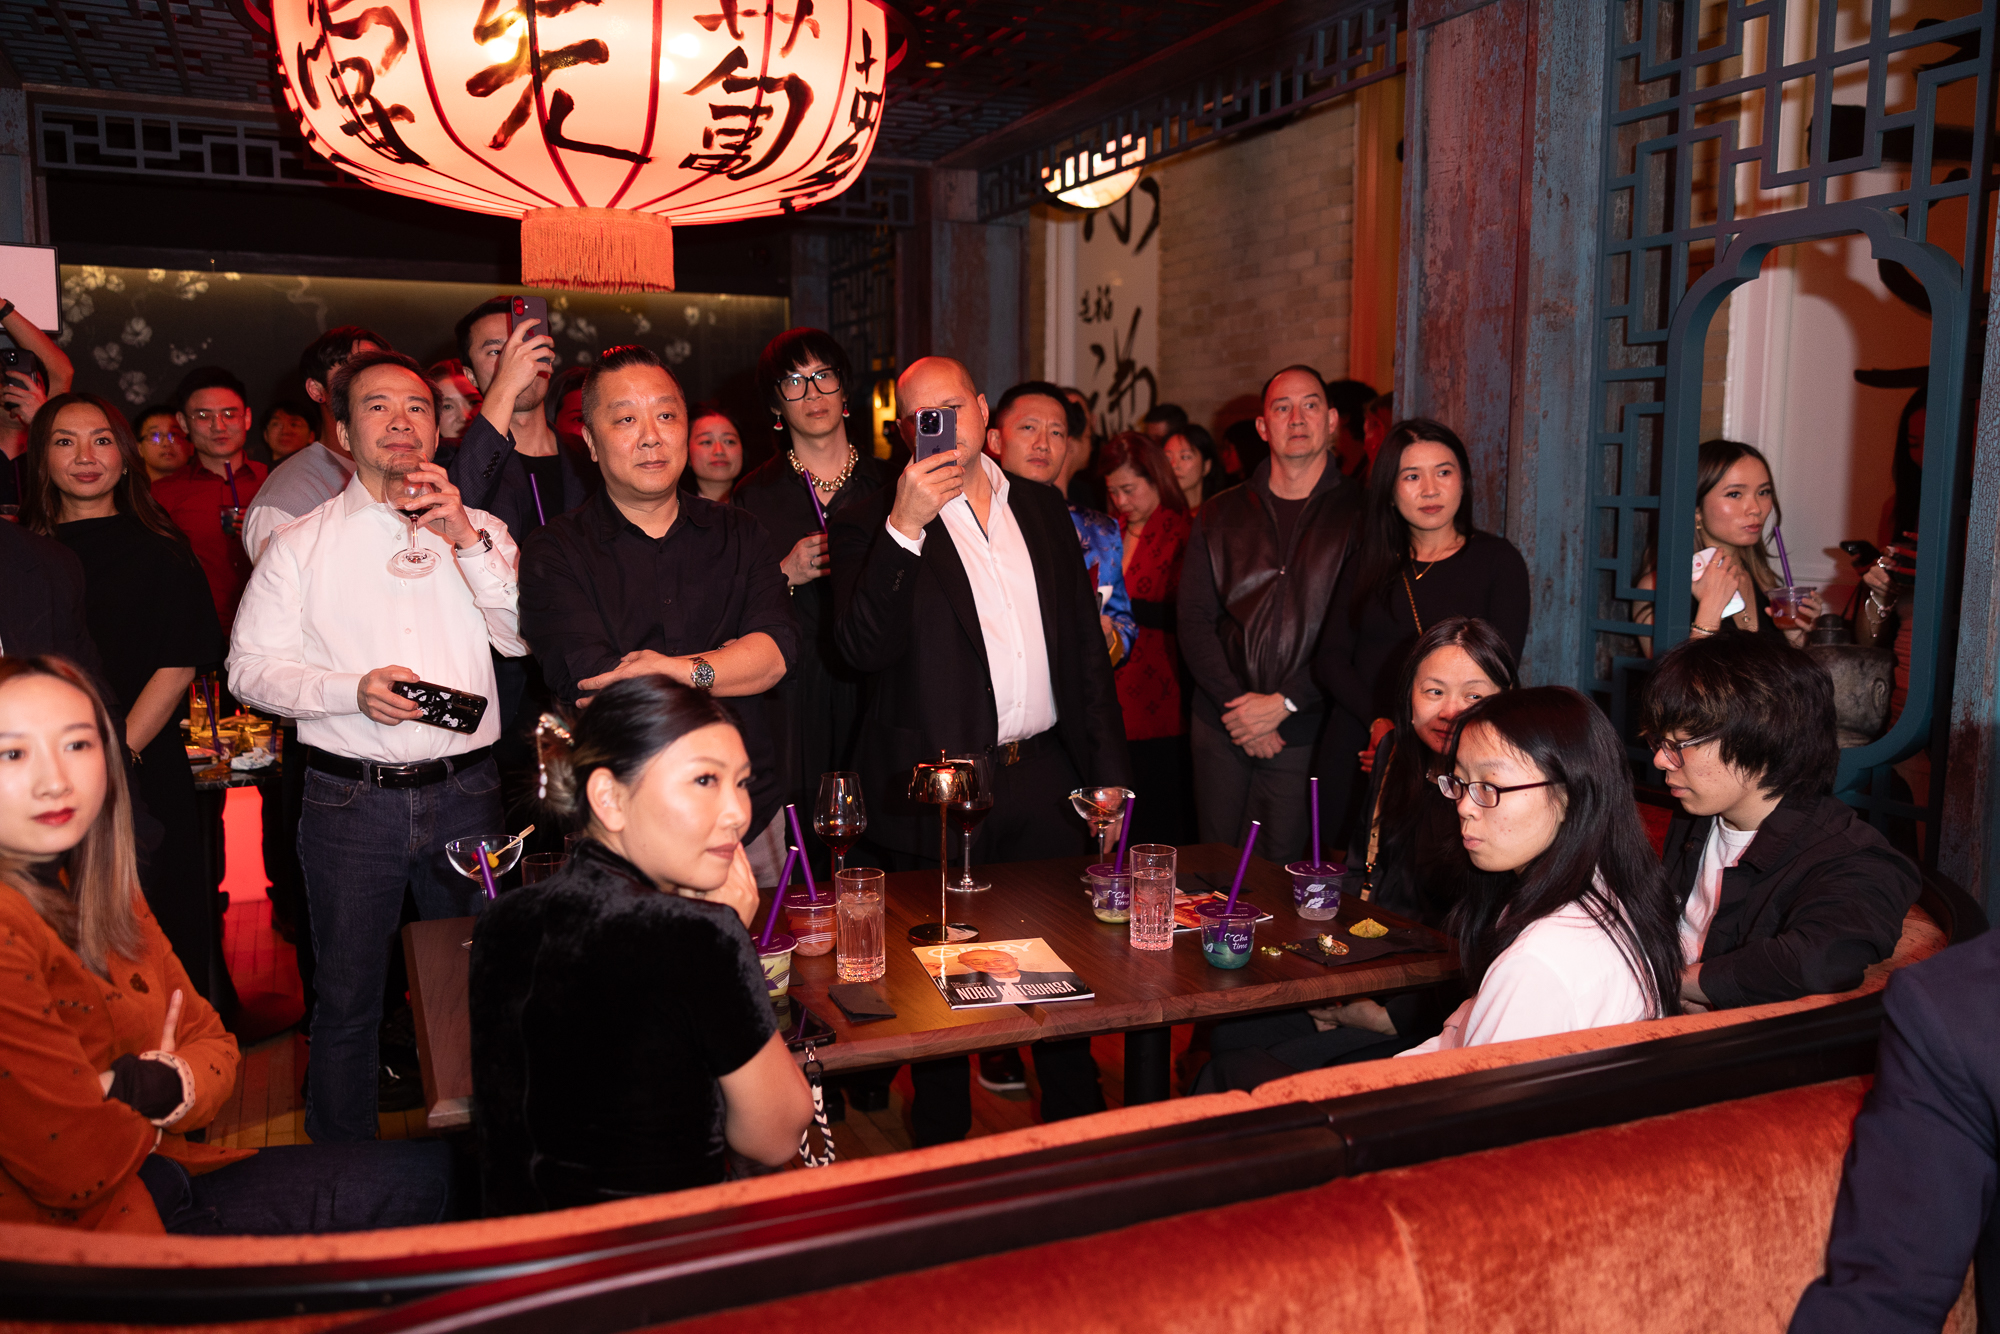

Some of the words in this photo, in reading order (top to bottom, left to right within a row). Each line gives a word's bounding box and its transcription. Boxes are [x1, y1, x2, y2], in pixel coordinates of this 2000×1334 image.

[1232, 933, 1248, 942] Cha
[1232, 942, 1248, 950] time
[955, 985, 997, 1001] NOBU
